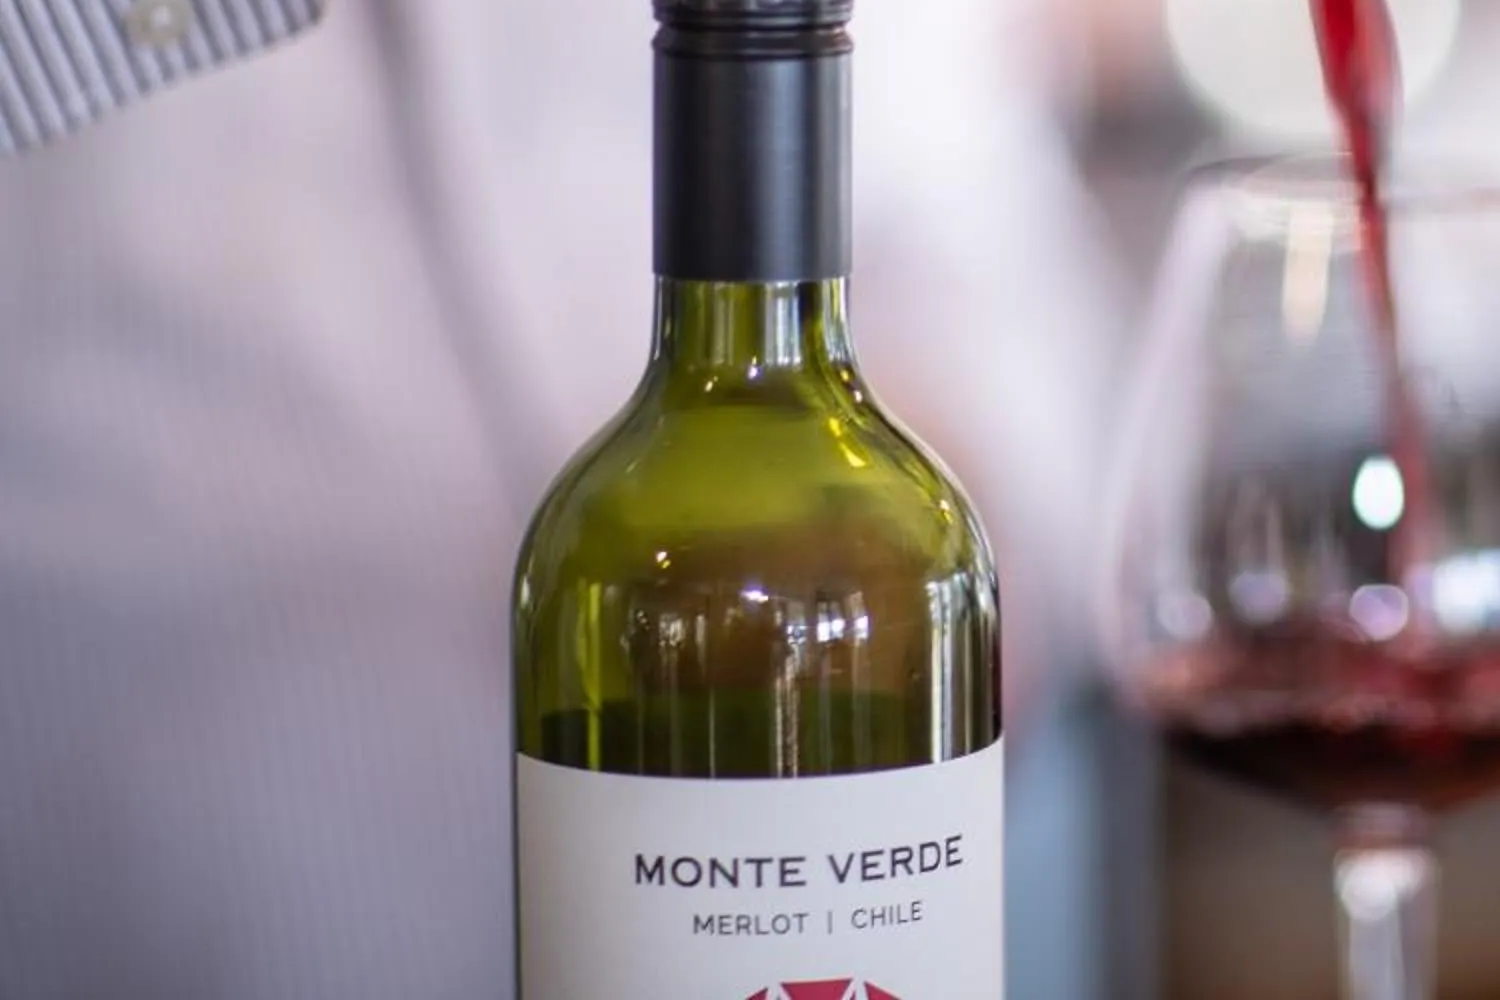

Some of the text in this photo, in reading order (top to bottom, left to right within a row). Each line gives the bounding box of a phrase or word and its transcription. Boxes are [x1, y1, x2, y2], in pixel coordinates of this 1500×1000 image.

[634, 833, 965, 889] MONTE VERDE
[692, 913, 809, 936] MERLOT
[850, 900, 924, 931] CHILE
